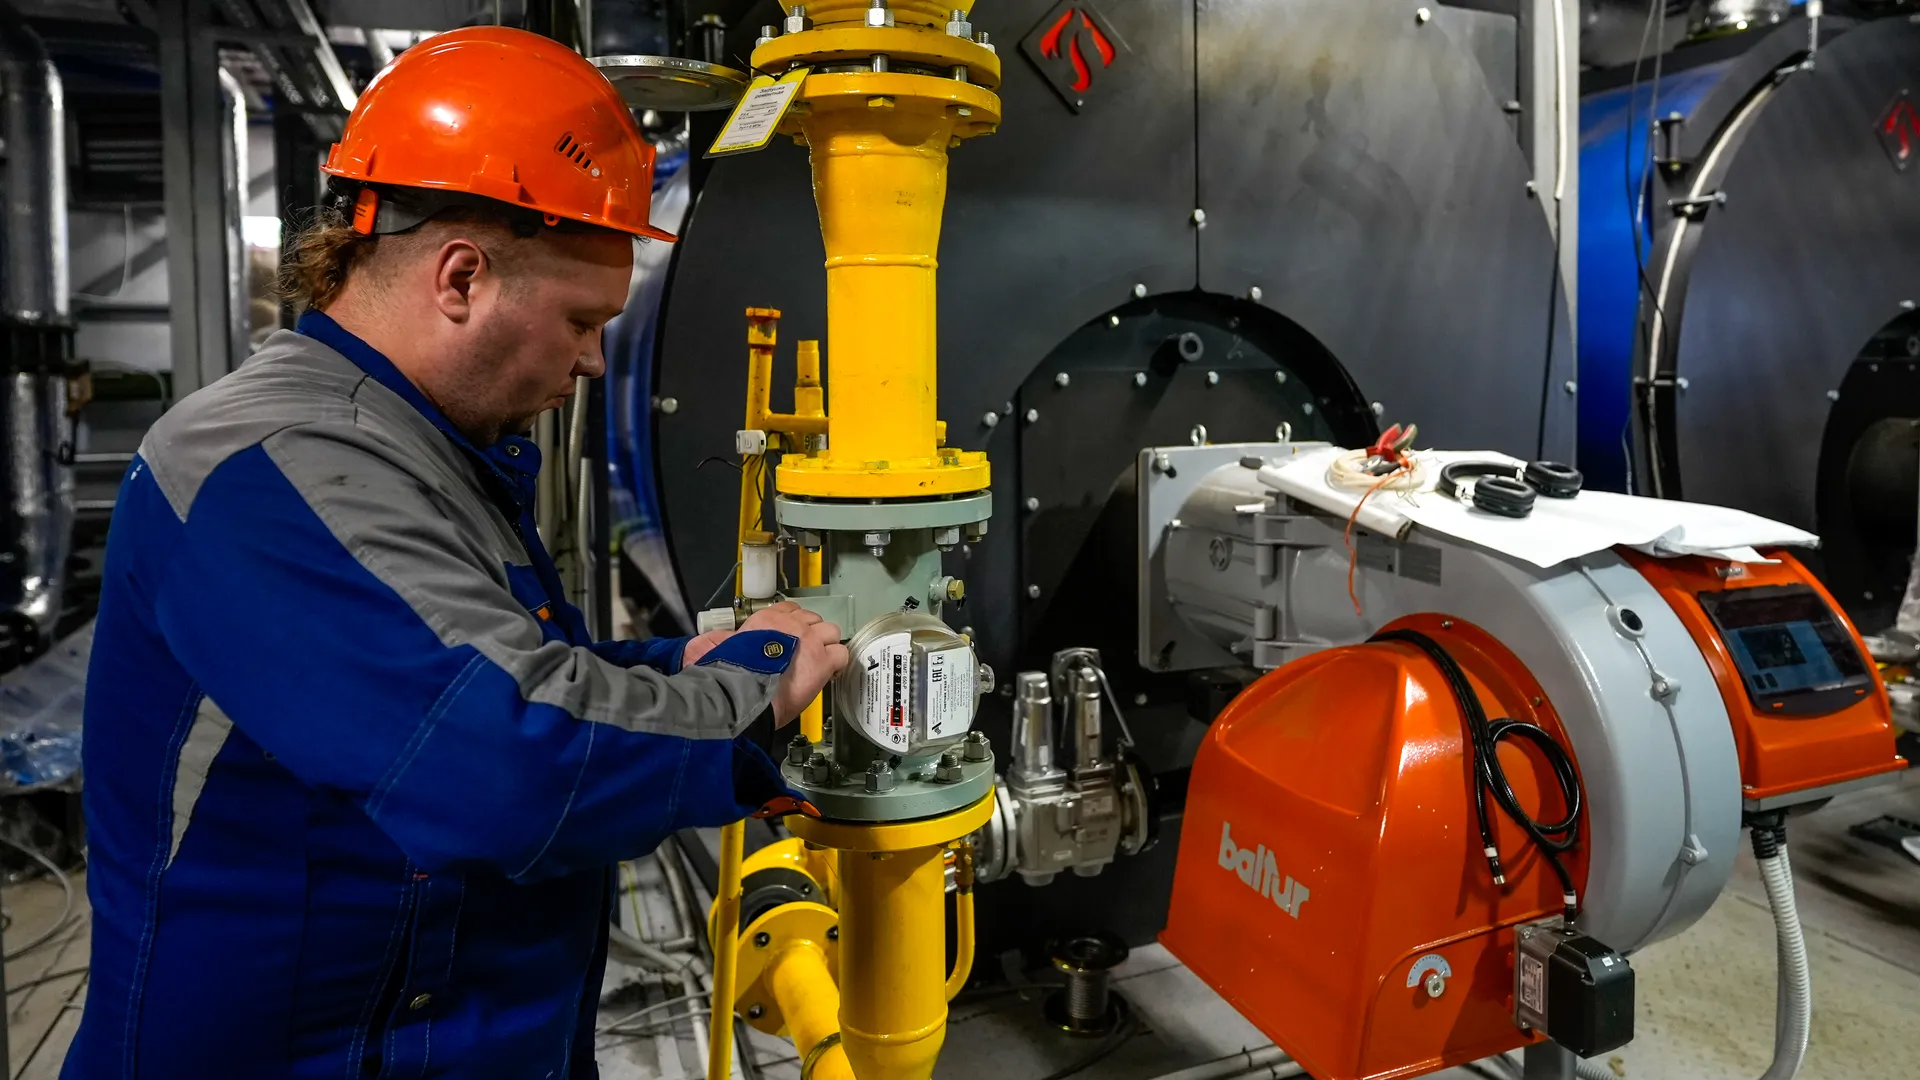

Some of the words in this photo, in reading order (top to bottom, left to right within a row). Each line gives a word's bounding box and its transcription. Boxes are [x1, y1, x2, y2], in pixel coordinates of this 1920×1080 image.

[933, 656, 944, 666] Ex
[932, 668, 942, 682] EAC
[1218, 820, 1311, 920] baltur
